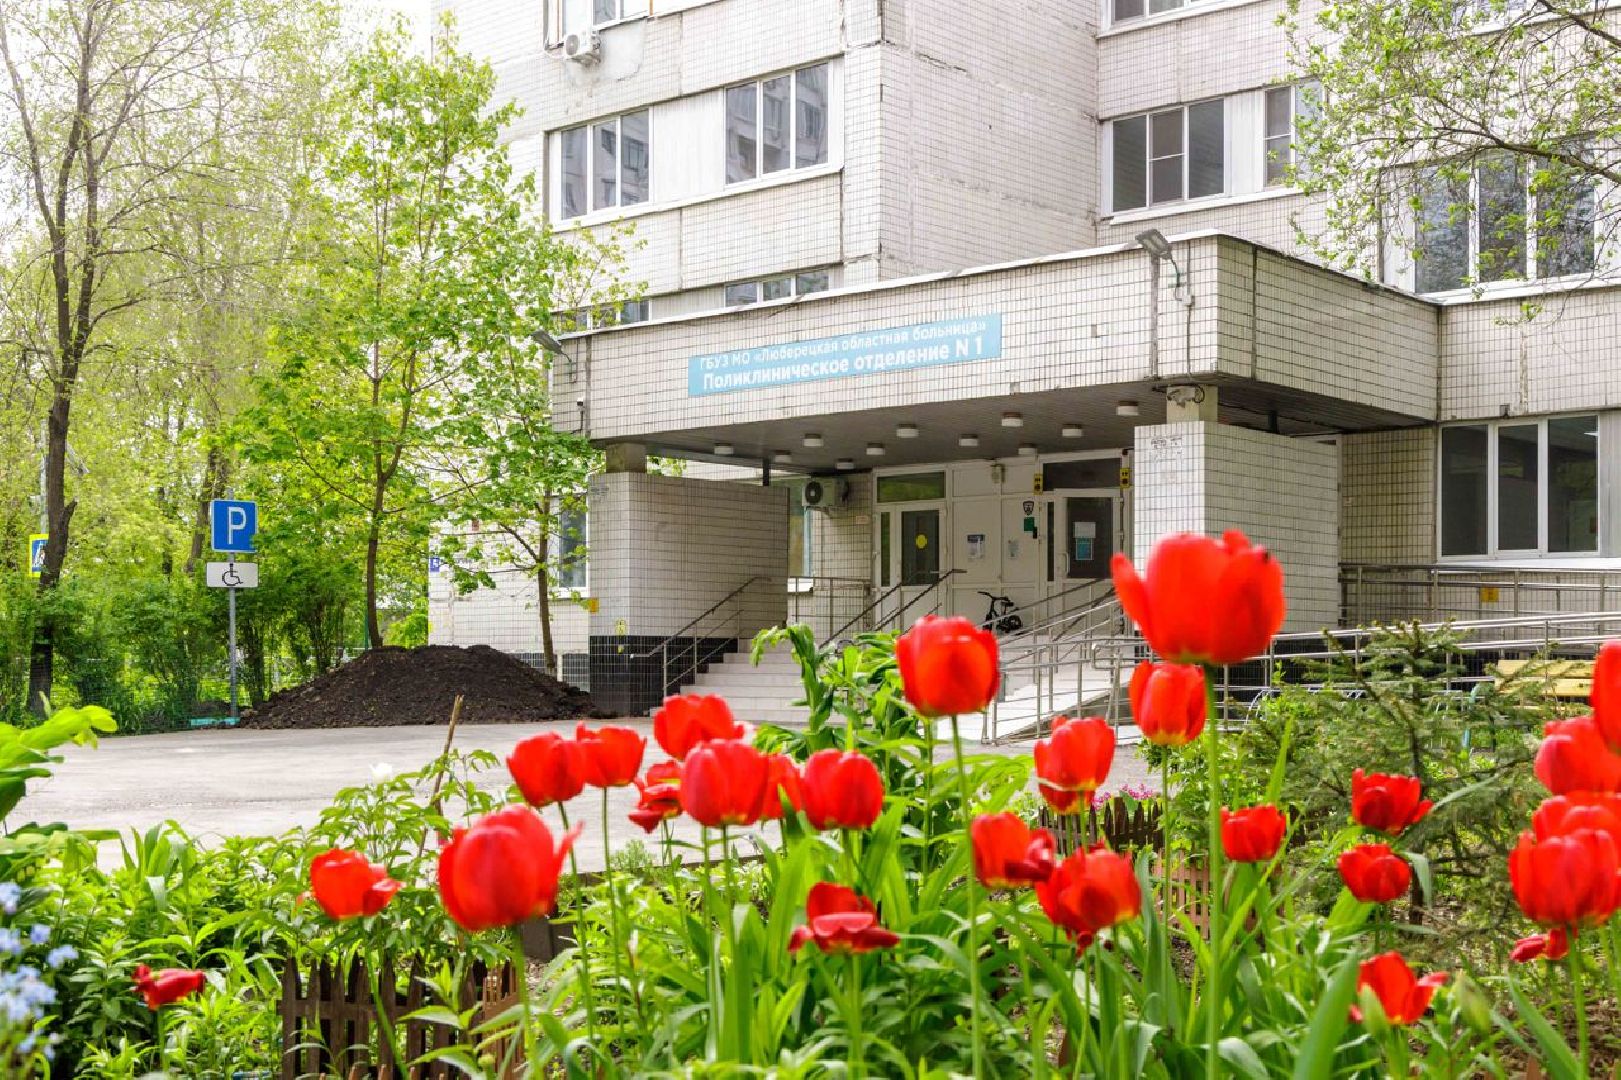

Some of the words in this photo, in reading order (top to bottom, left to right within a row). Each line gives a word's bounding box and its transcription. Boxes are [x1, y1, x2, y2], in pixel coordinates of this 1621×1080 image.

[700, 354, 729, 370] ГБУЗ
[732, 352, 750, 366] МО
[753, 341, 838, 361] «Люберецкая
[842, 331, 909, 351] областная
[913, 320, 986, 341] больница»
[703, 357, 849, 390] Поликлиническое
[854, 344, 949, 371] отделение
[956, 338, 969, 357] N
[975, 336, 983, 355] 1
[227, 506, 247, 545] P
